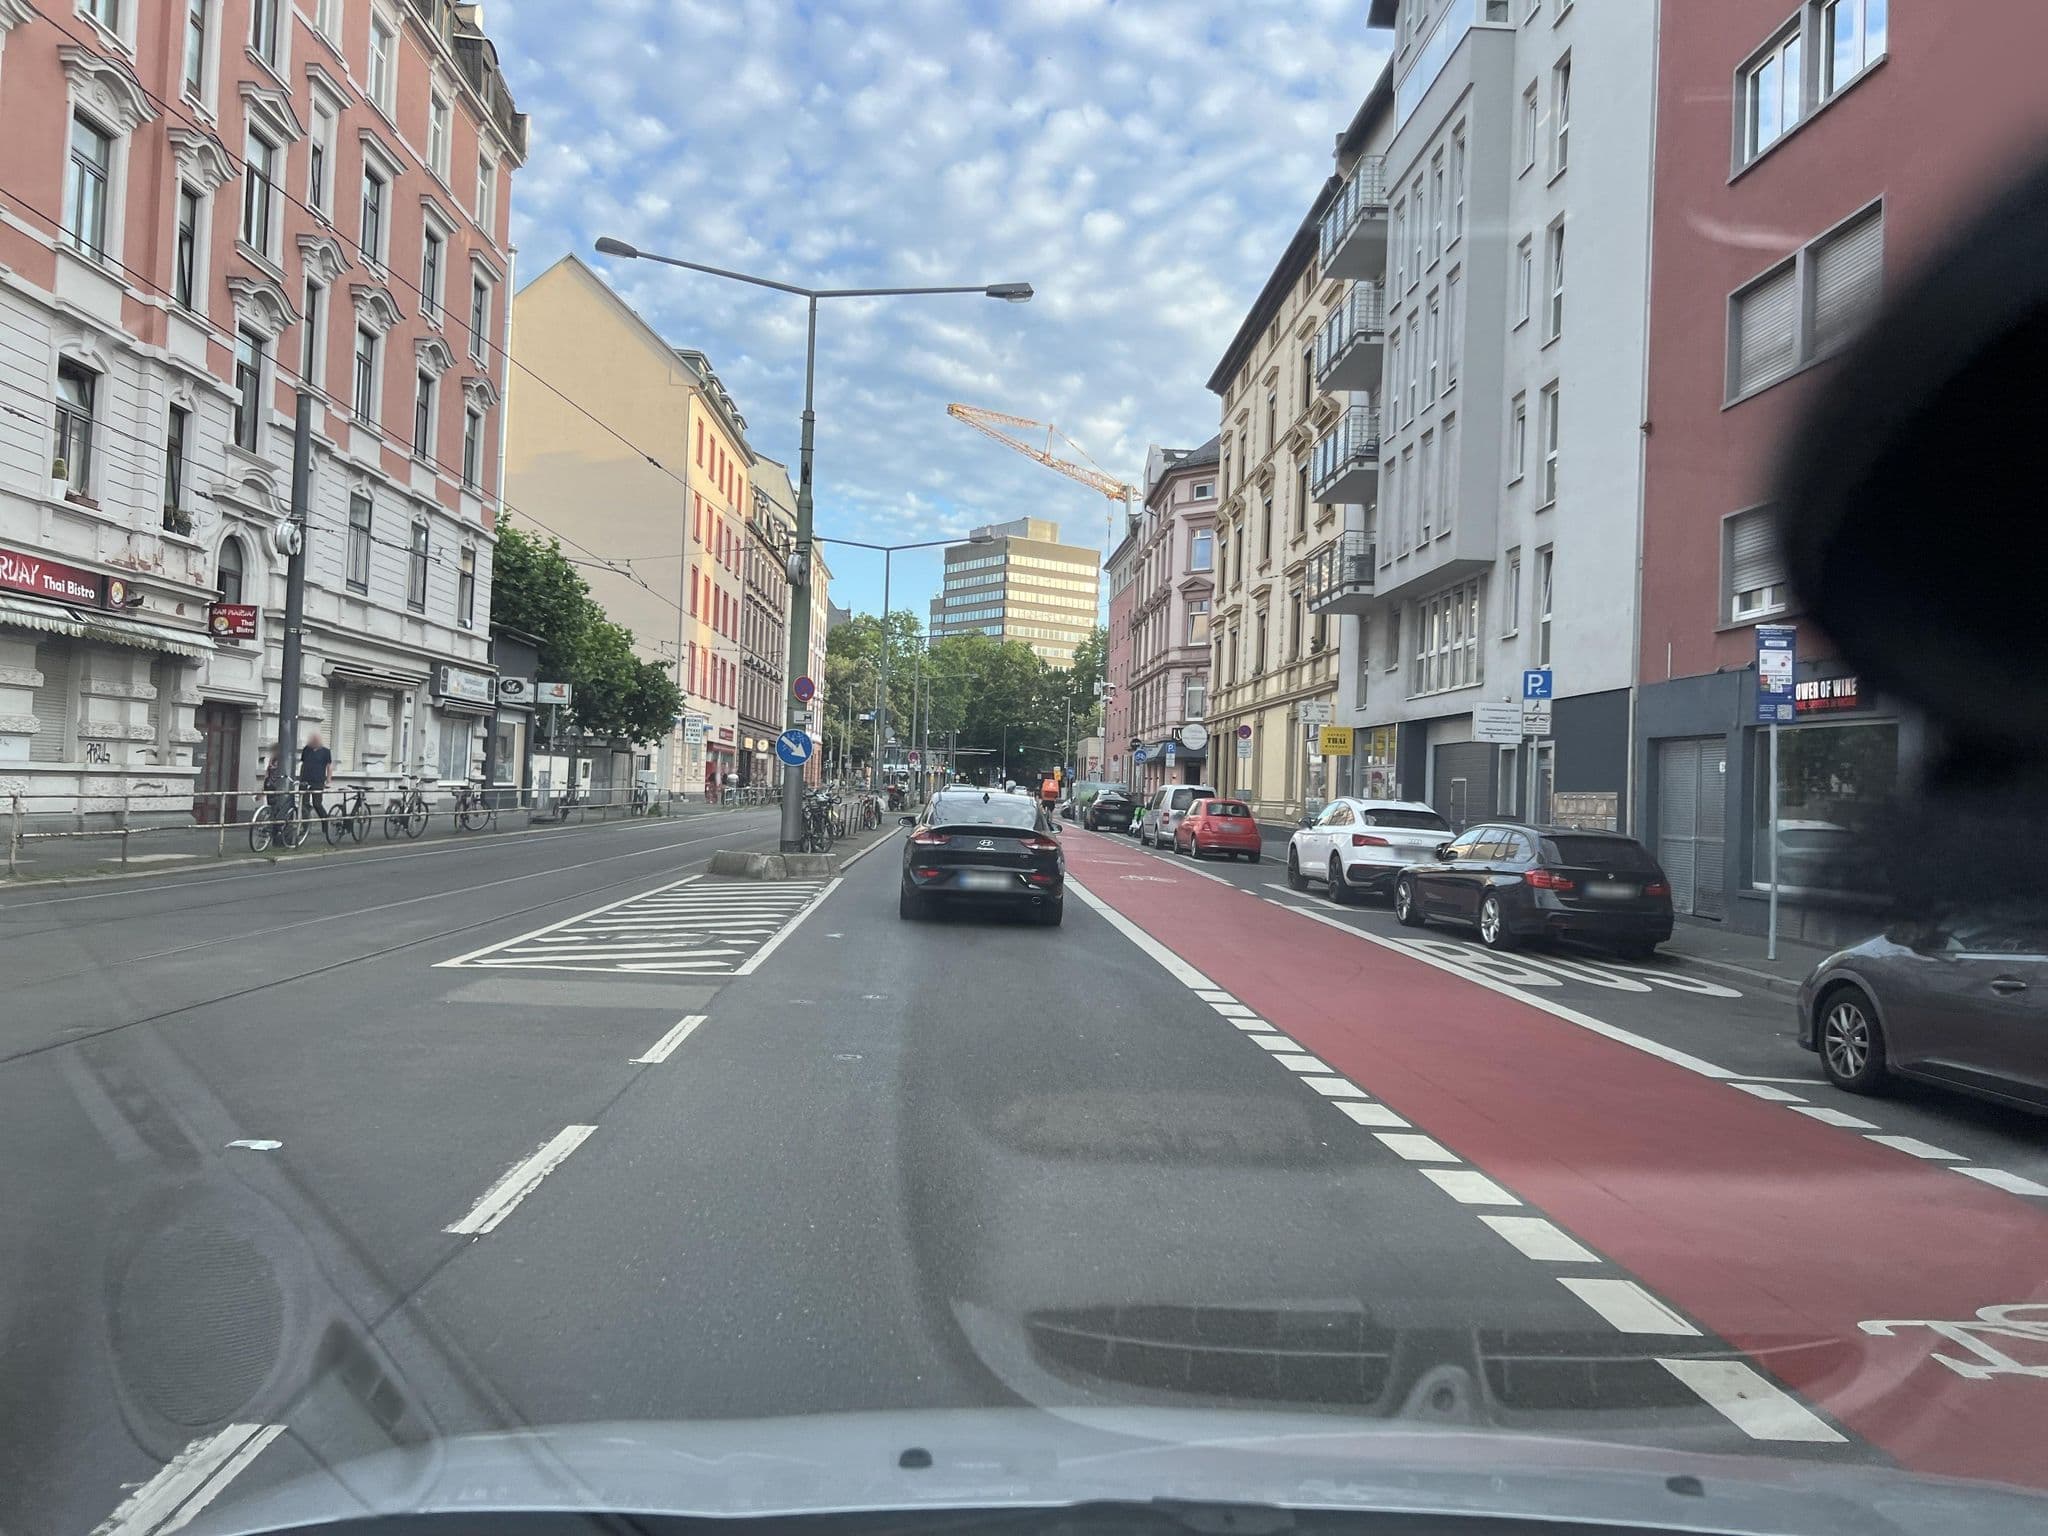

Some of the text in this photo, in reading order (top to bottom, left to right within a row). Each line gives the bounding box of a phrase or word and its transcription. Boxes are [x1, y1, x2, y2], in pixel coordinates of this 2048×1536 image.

[43, 575, 65, 593] Thai
[67, 580, 95, 599] Bistro
[236, 626, 255, 634] Bistro
[241, 619, 255, 627] Thai
[1527, 673, 1544, 695] P
[1820, 680, 1831, 698] OF
[1833, 677, 1857, 697] WINE
[1389, 938, 1743, 998] BUS
